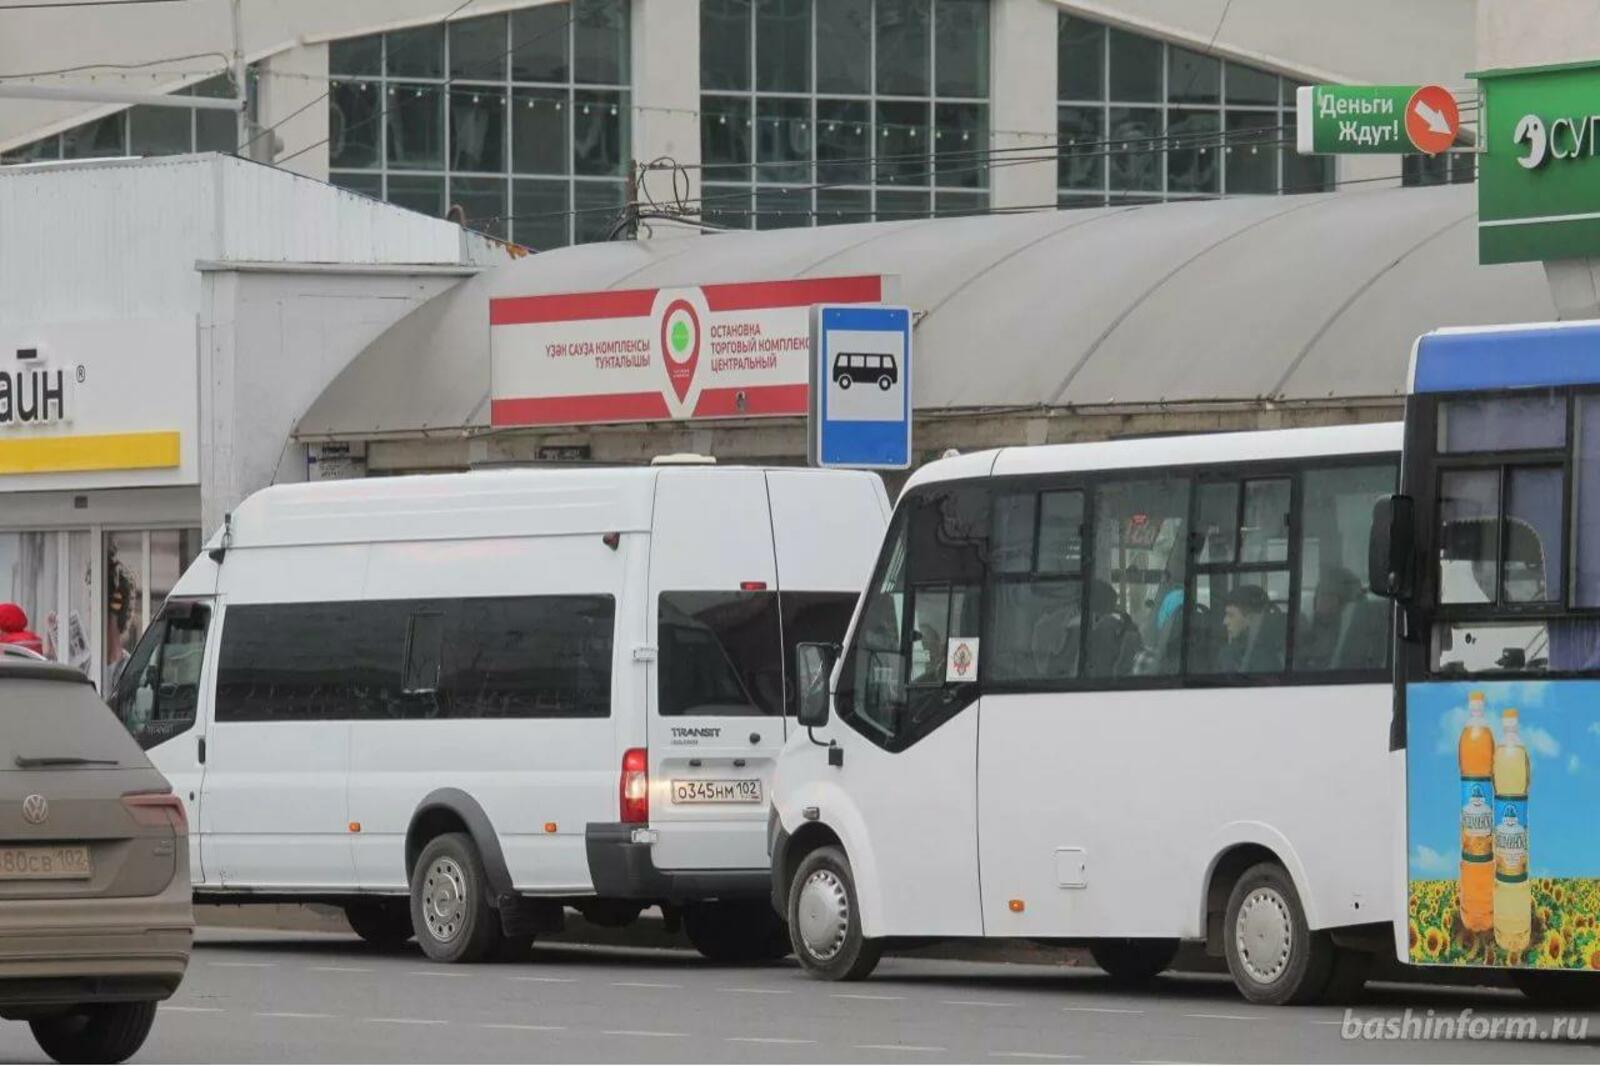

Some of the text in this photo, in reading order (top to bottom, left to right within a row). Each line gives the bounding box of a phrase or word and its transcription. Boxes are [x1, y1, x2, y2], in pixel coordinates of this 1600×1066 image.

[1319, 93, 1393, 118] Деньги
[1338, 119, 1399, 146] Ждут!
[710, 323, 761, 338] ОСТАНОВКА
[595, 338, 650, 354] КОМПЛЕКСЫ
[710, 337, 757, 354] ТОРГОВЫЙ
[710, 352, 777, 374] ЦЕНТРАЛЬНЫЙ
[671, 727, 721, 738] TRANSIT
[736, 781, 757, 795] 102
